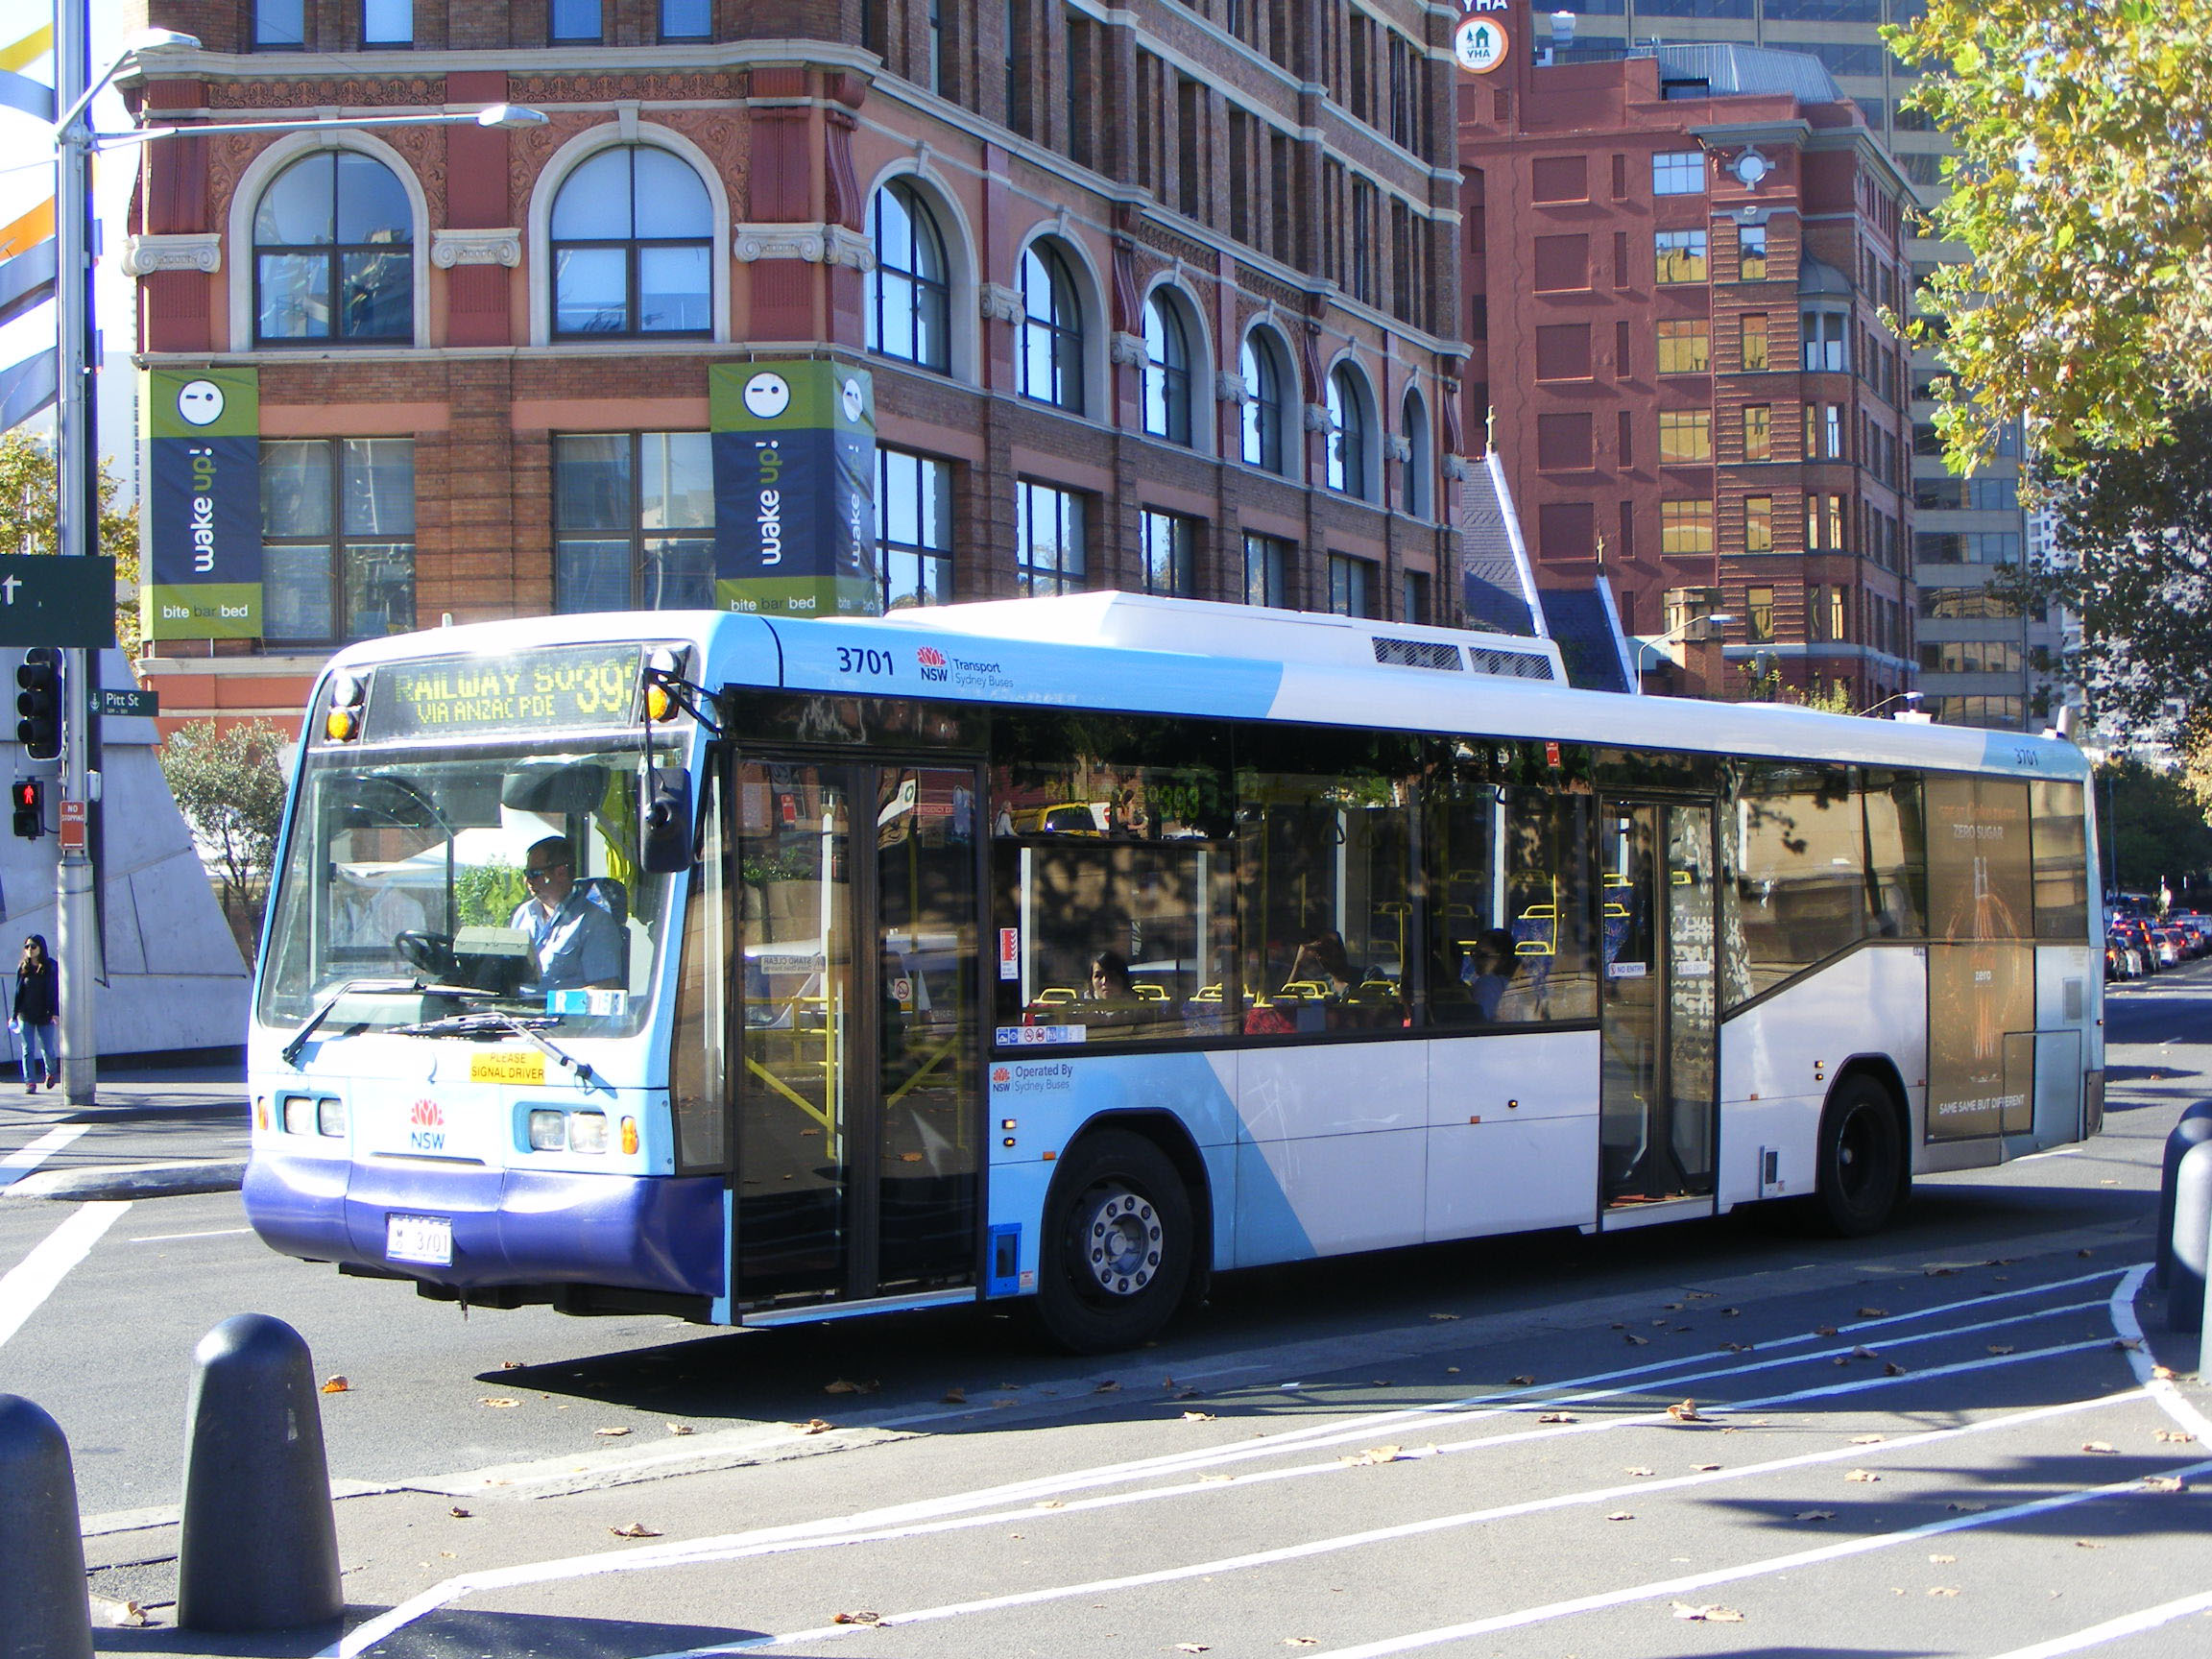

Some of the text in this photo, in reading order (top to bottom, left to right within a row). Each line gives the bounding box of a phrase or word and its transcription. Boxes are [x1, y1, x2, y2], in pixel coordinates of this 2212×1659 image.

[1462, 0, 1508, 12] YHA
[1467, 49, 1490, 59] YHA
[188, 447, 217, 572] wake up!
[755, 441, 783, 565] wake up!
[851, 493, 861, 567] wake
[0, 574, 22, 605] t
[162, 604, 248, 618] bite bar bed
[731, 596, 816, 612] bite bar bed
[837, 597, 852, 610] bite
[836, 646, 894, 676] 3701
[952, 658, 1001, 674] Transport
[921, 667, 949, 683] NSW
[954, 672, 1014, 688] Sydney Buses
[395, 666, 521, 702] RAILWAY
[107, 693, 139, 707] Pitt St
[416, 694, 556, 724] VIA ANZAC PDE
[2013, 747, 2038, 766] 3701
[67, 805, 79, 813] NO
[1953, 824, 2004, 840] ZERO SUGAR
[1975, 970, 1992, 981] zero
[490, 1052, 526, 1064] PLEASE
[470, 1066, 544, 1080] SIGNAL DRIVER
[1015, 1063, 1073, 1080] Operated By
[993, 1082, 1011, 1093] NSW
[1014, 1078, 1070, 1094] Sydney Buses
[1938, 1094, 2025, 1115] SAME SAME BUT DIFFERENT
[411, 1131, 445, 1150] NSW
